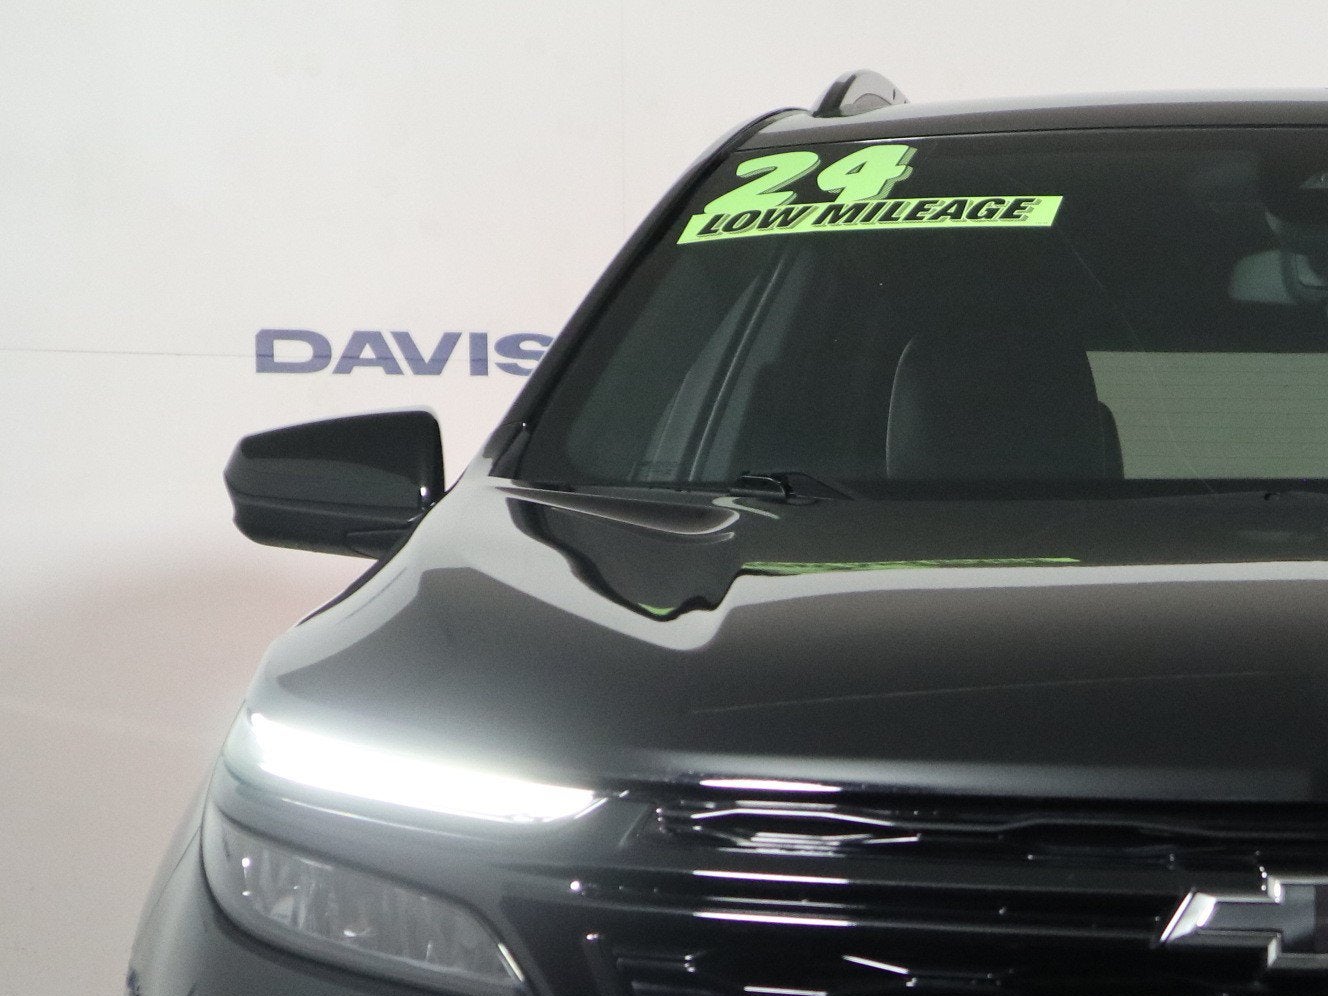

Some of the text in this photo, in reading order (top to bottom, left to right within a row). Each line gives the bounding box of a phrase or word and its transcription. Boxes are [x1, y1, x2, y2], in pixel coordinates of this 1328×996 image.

[704, 144, 917, 214] 24
[697, 197, 1037, 237] LOW MILEAGE
[255, 328, 554, 376] DAVIS
